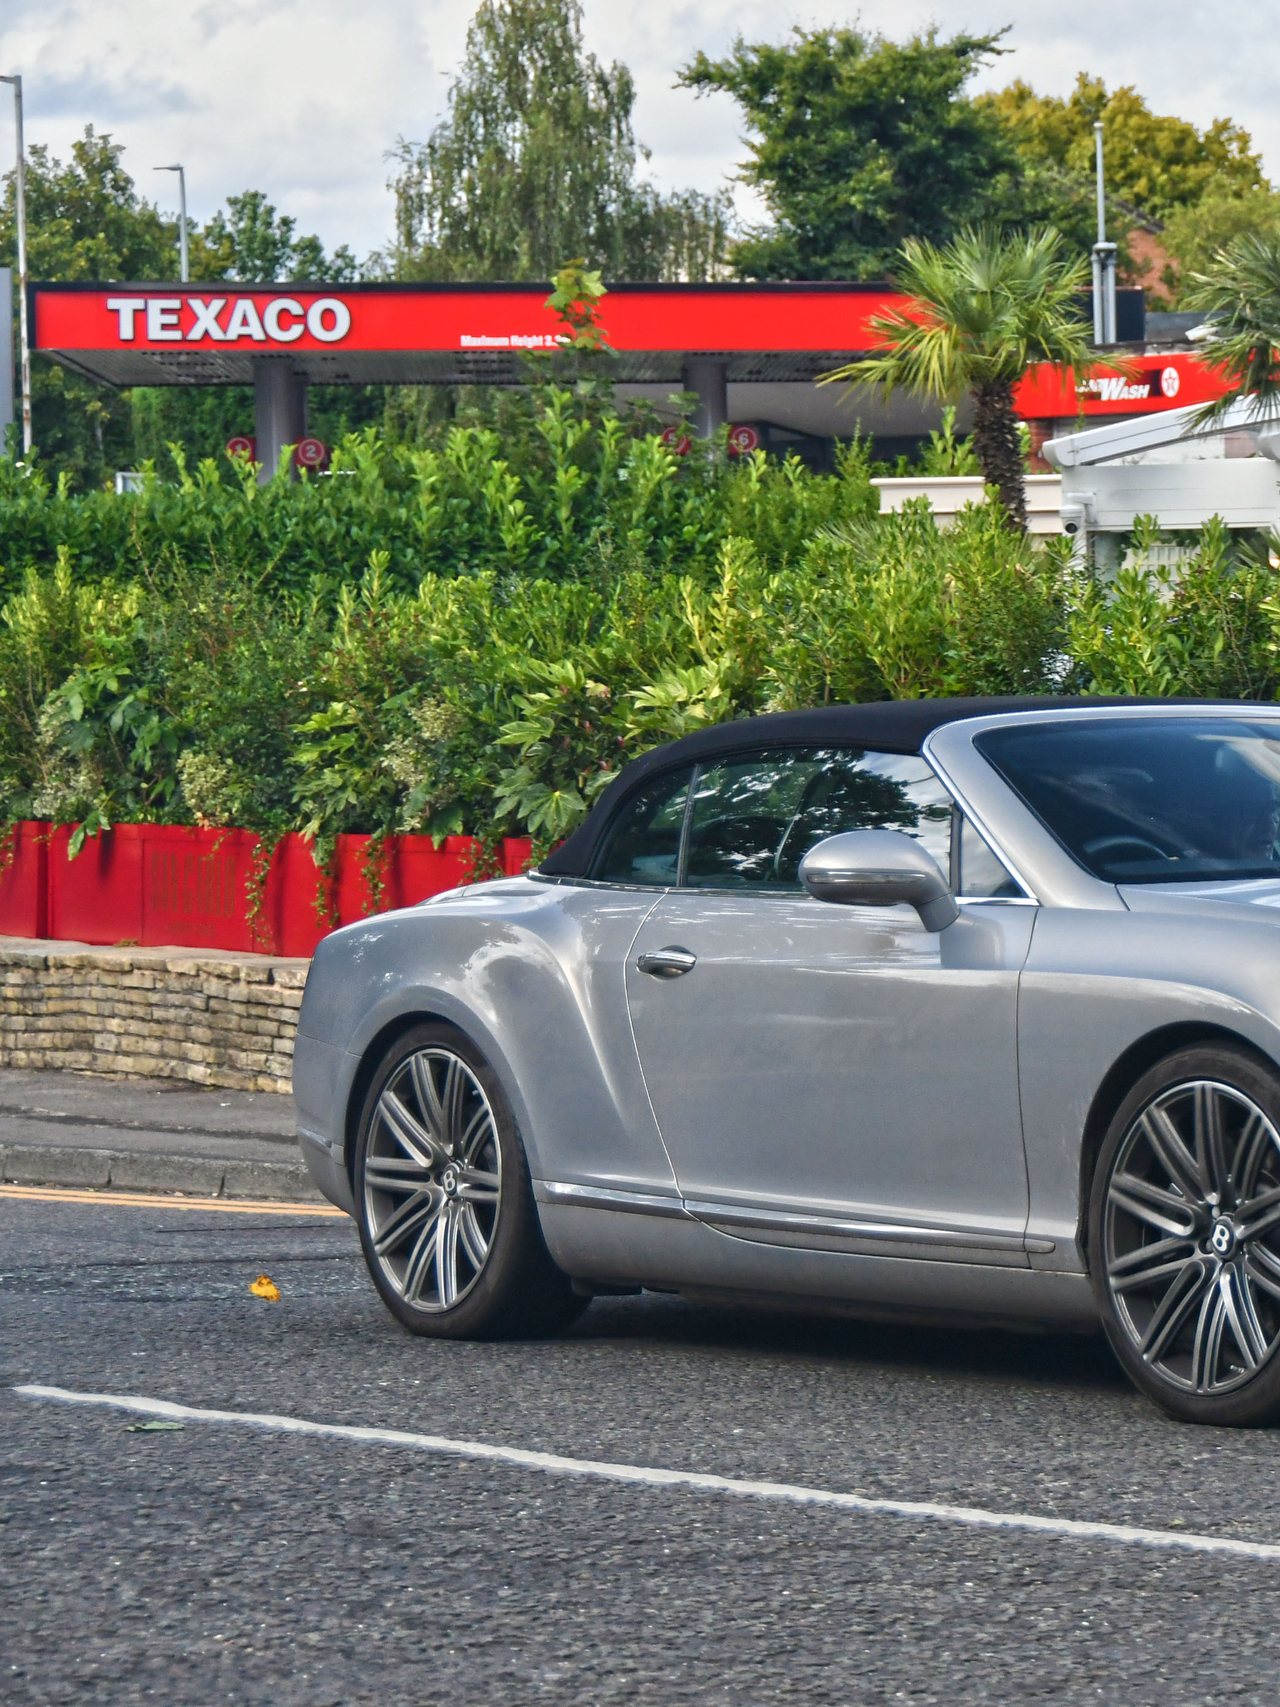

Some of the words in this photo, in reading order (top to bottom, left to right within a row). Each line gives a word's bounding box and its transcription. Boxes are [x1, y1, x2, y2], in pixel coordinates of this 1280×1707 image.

[107, 298, 351, 342] TEXACO
[510, 335, 543, 348] Height
[739, 433, 749, 446] 6
[306, 445, 316, 458] 2
